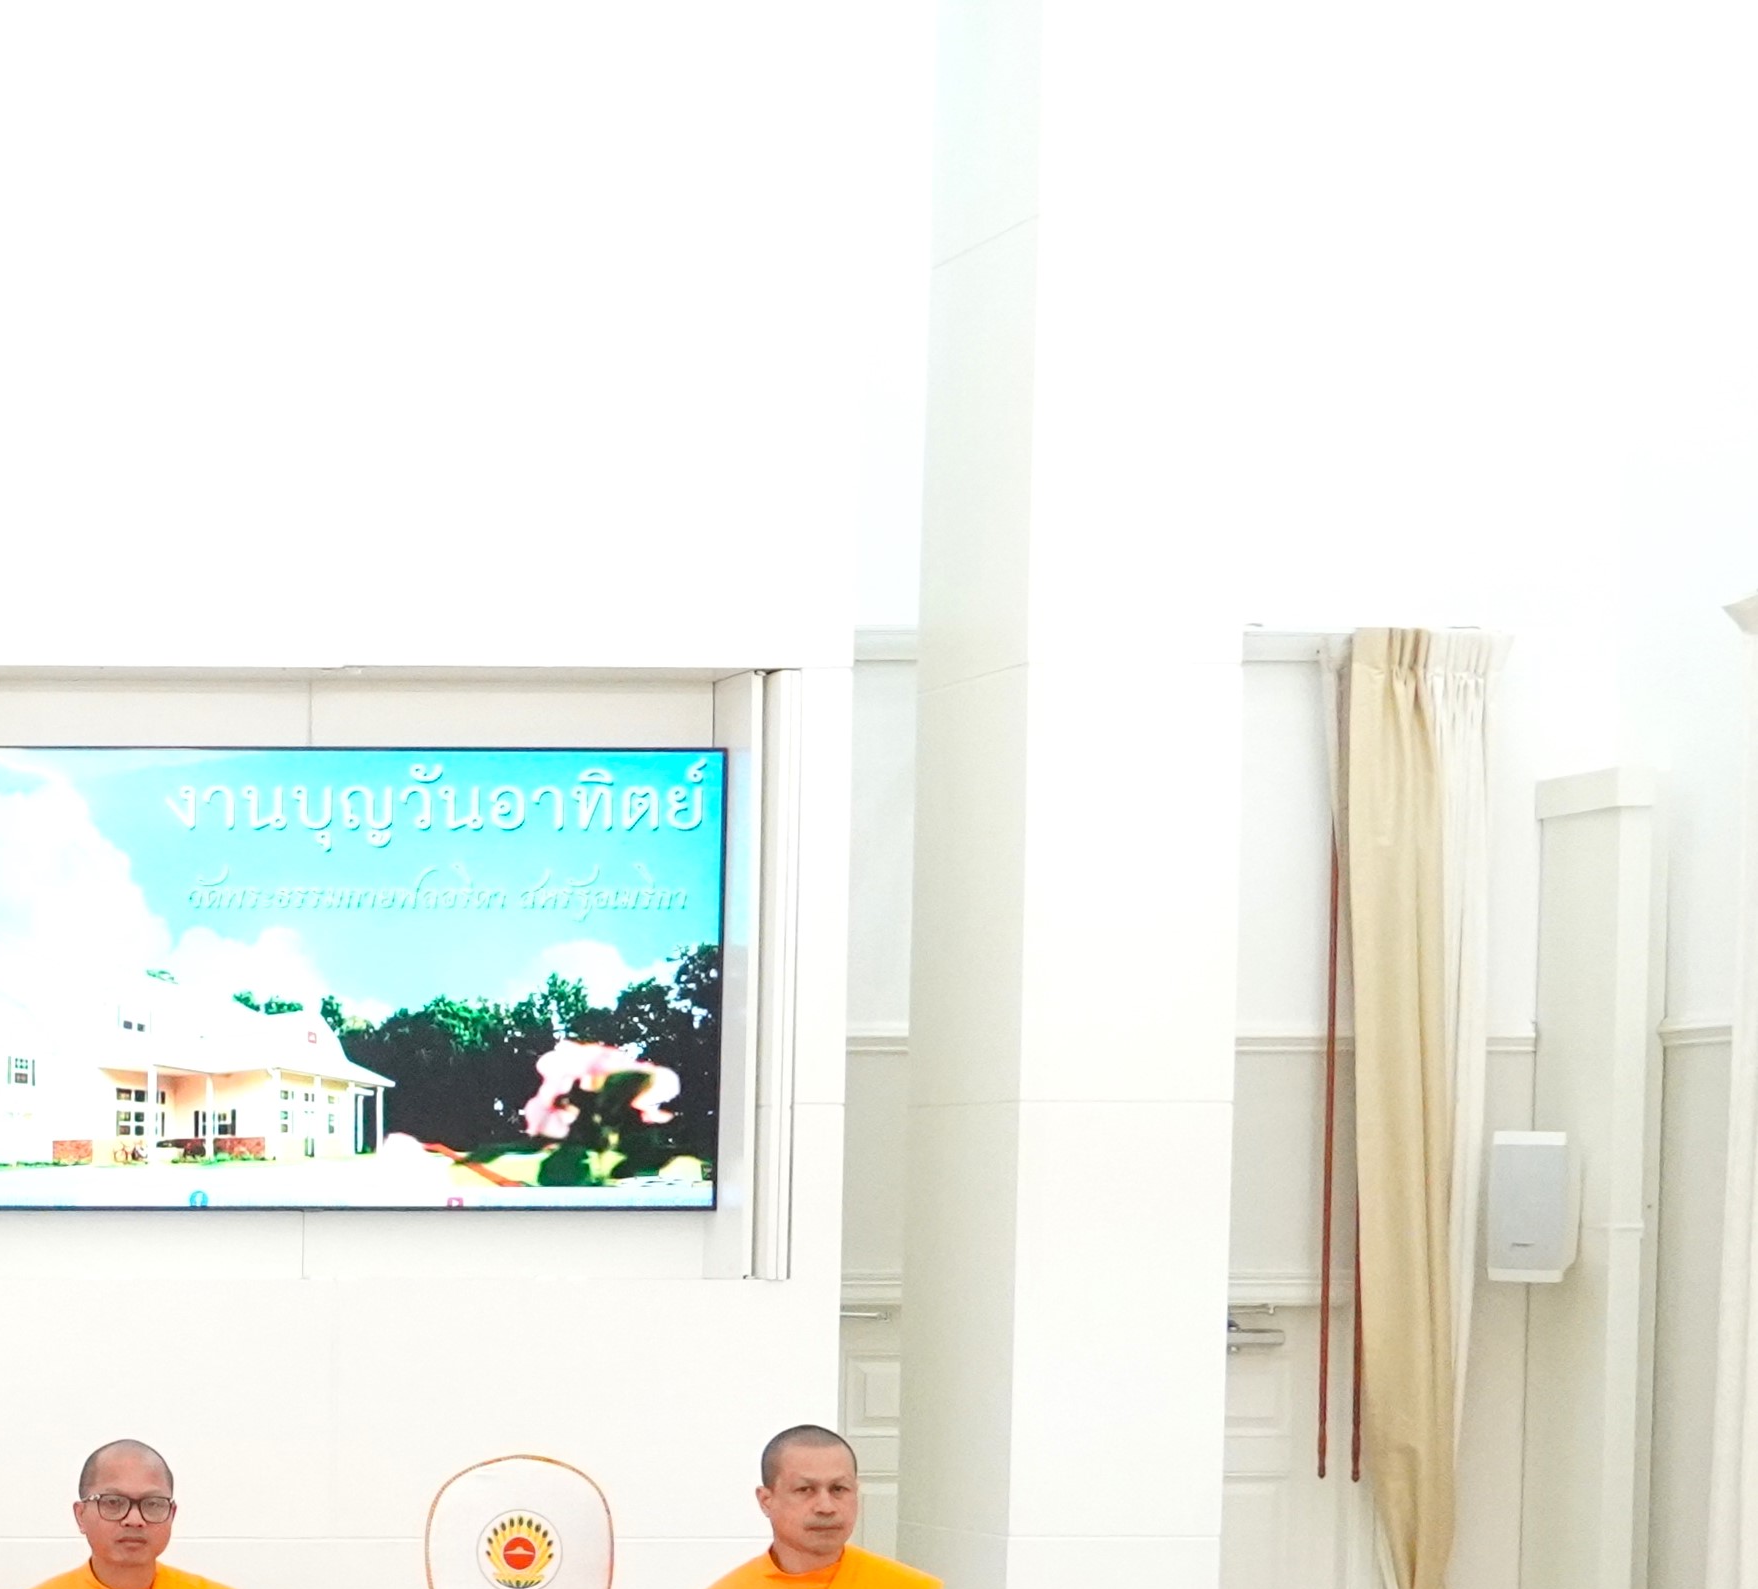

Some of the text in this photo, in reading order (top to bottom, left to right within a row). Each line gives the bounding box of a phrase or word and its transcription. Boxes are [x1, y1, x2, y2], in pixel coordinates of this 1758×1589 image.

[166, 757, 709, 853] งานบุญวันอาทิตย์
